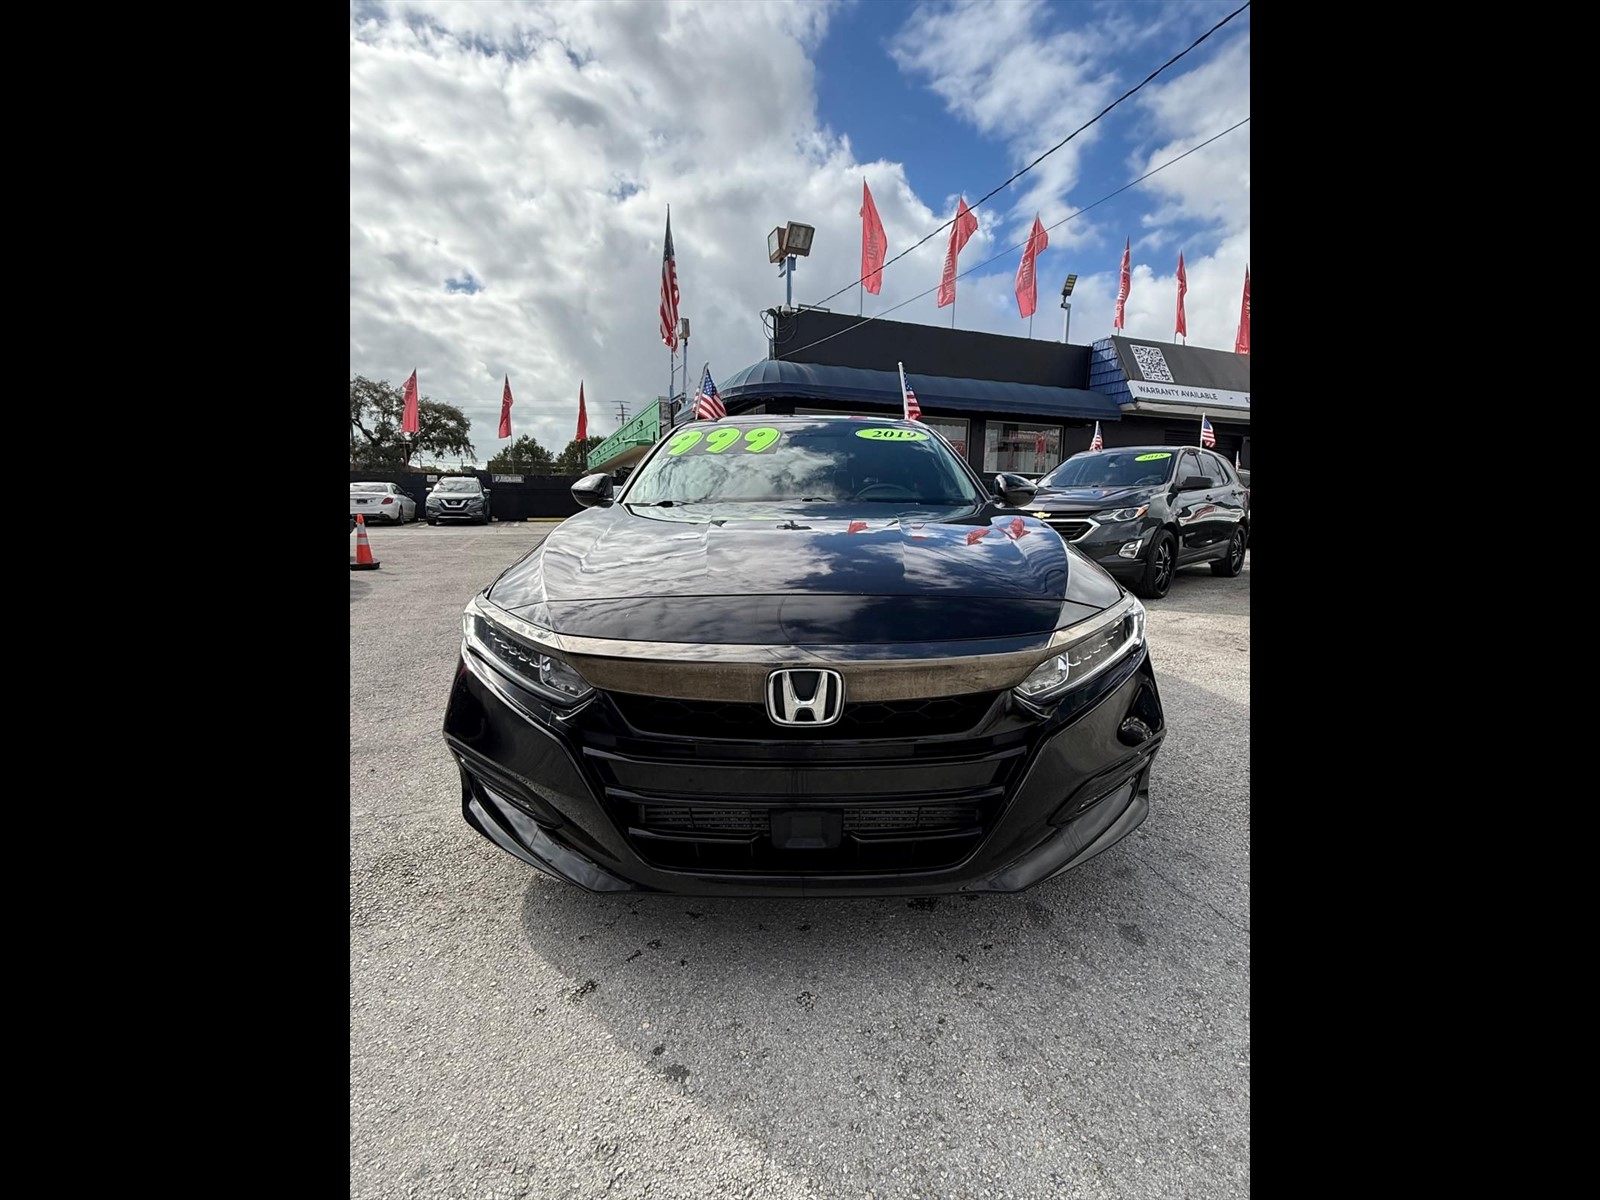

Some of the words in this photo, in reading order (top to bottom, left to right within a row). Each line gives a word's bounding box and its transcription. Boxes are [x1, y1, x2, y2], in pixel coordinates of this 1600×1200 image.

[1138, 385, 1179, 397] WARRANTY
[1181, 390, 1218, 400] AVAILABLE
[667, 427, 781, 456] 999
[872, 430, 917, 439] 2019
